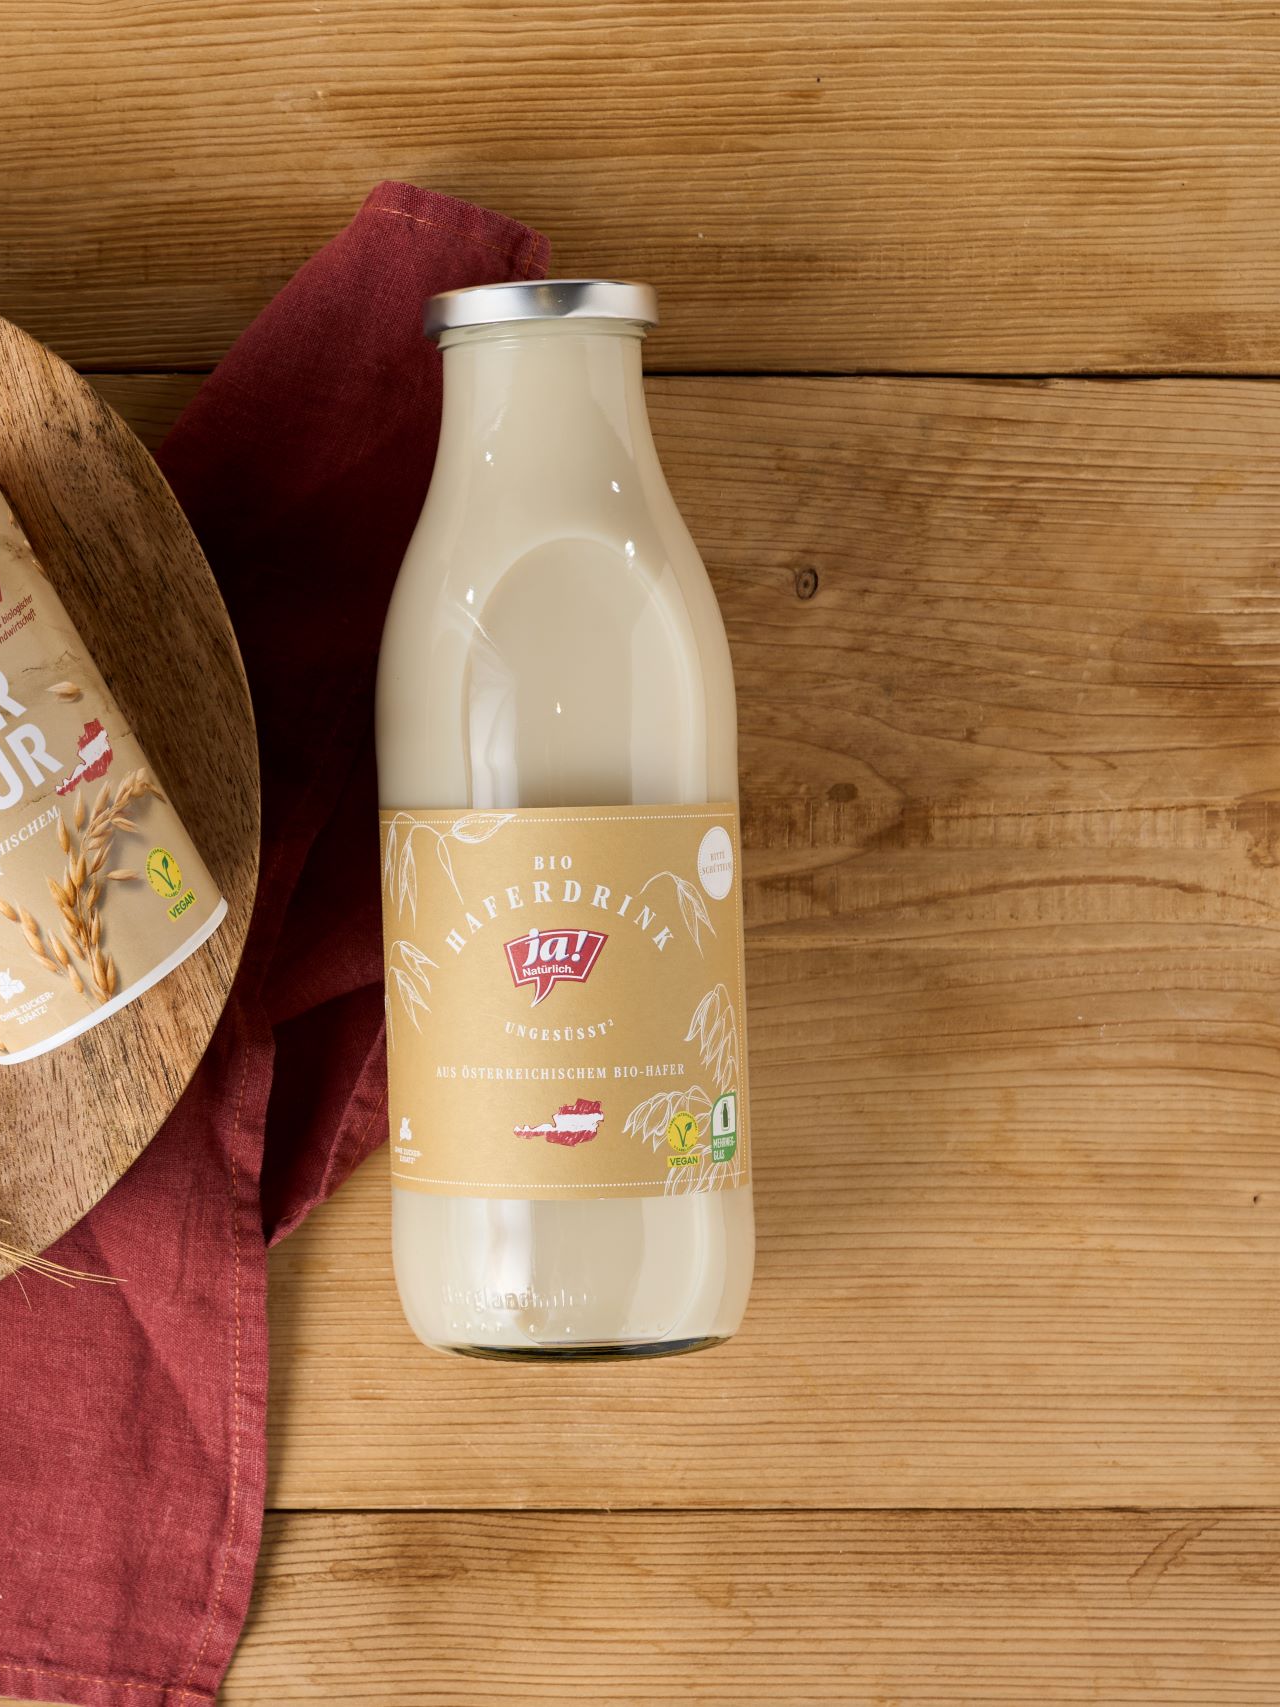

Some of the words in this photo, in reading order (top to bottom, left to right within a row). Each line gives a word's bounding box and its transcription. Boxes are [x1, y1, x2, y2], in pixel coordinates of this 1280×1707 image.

[2, 594, 33, 623] biologischer
[533, 855, 572, 870] BIO
[169, 891, 196, 918] VEGAN
[445, 880, 674, 955] HAFERDRINK
[522, 928, 589, 967] ja!
[522, 964, 575, 977] Natürlich.
[436, 1066, 457, 1078] AUS
[462, 1064, 607, 1080] ÖSTERREICHISCHEM
[614, 1063, 685, 1078] BIO-HAFER
[670, 1156, 698, 1166] VEGAN
